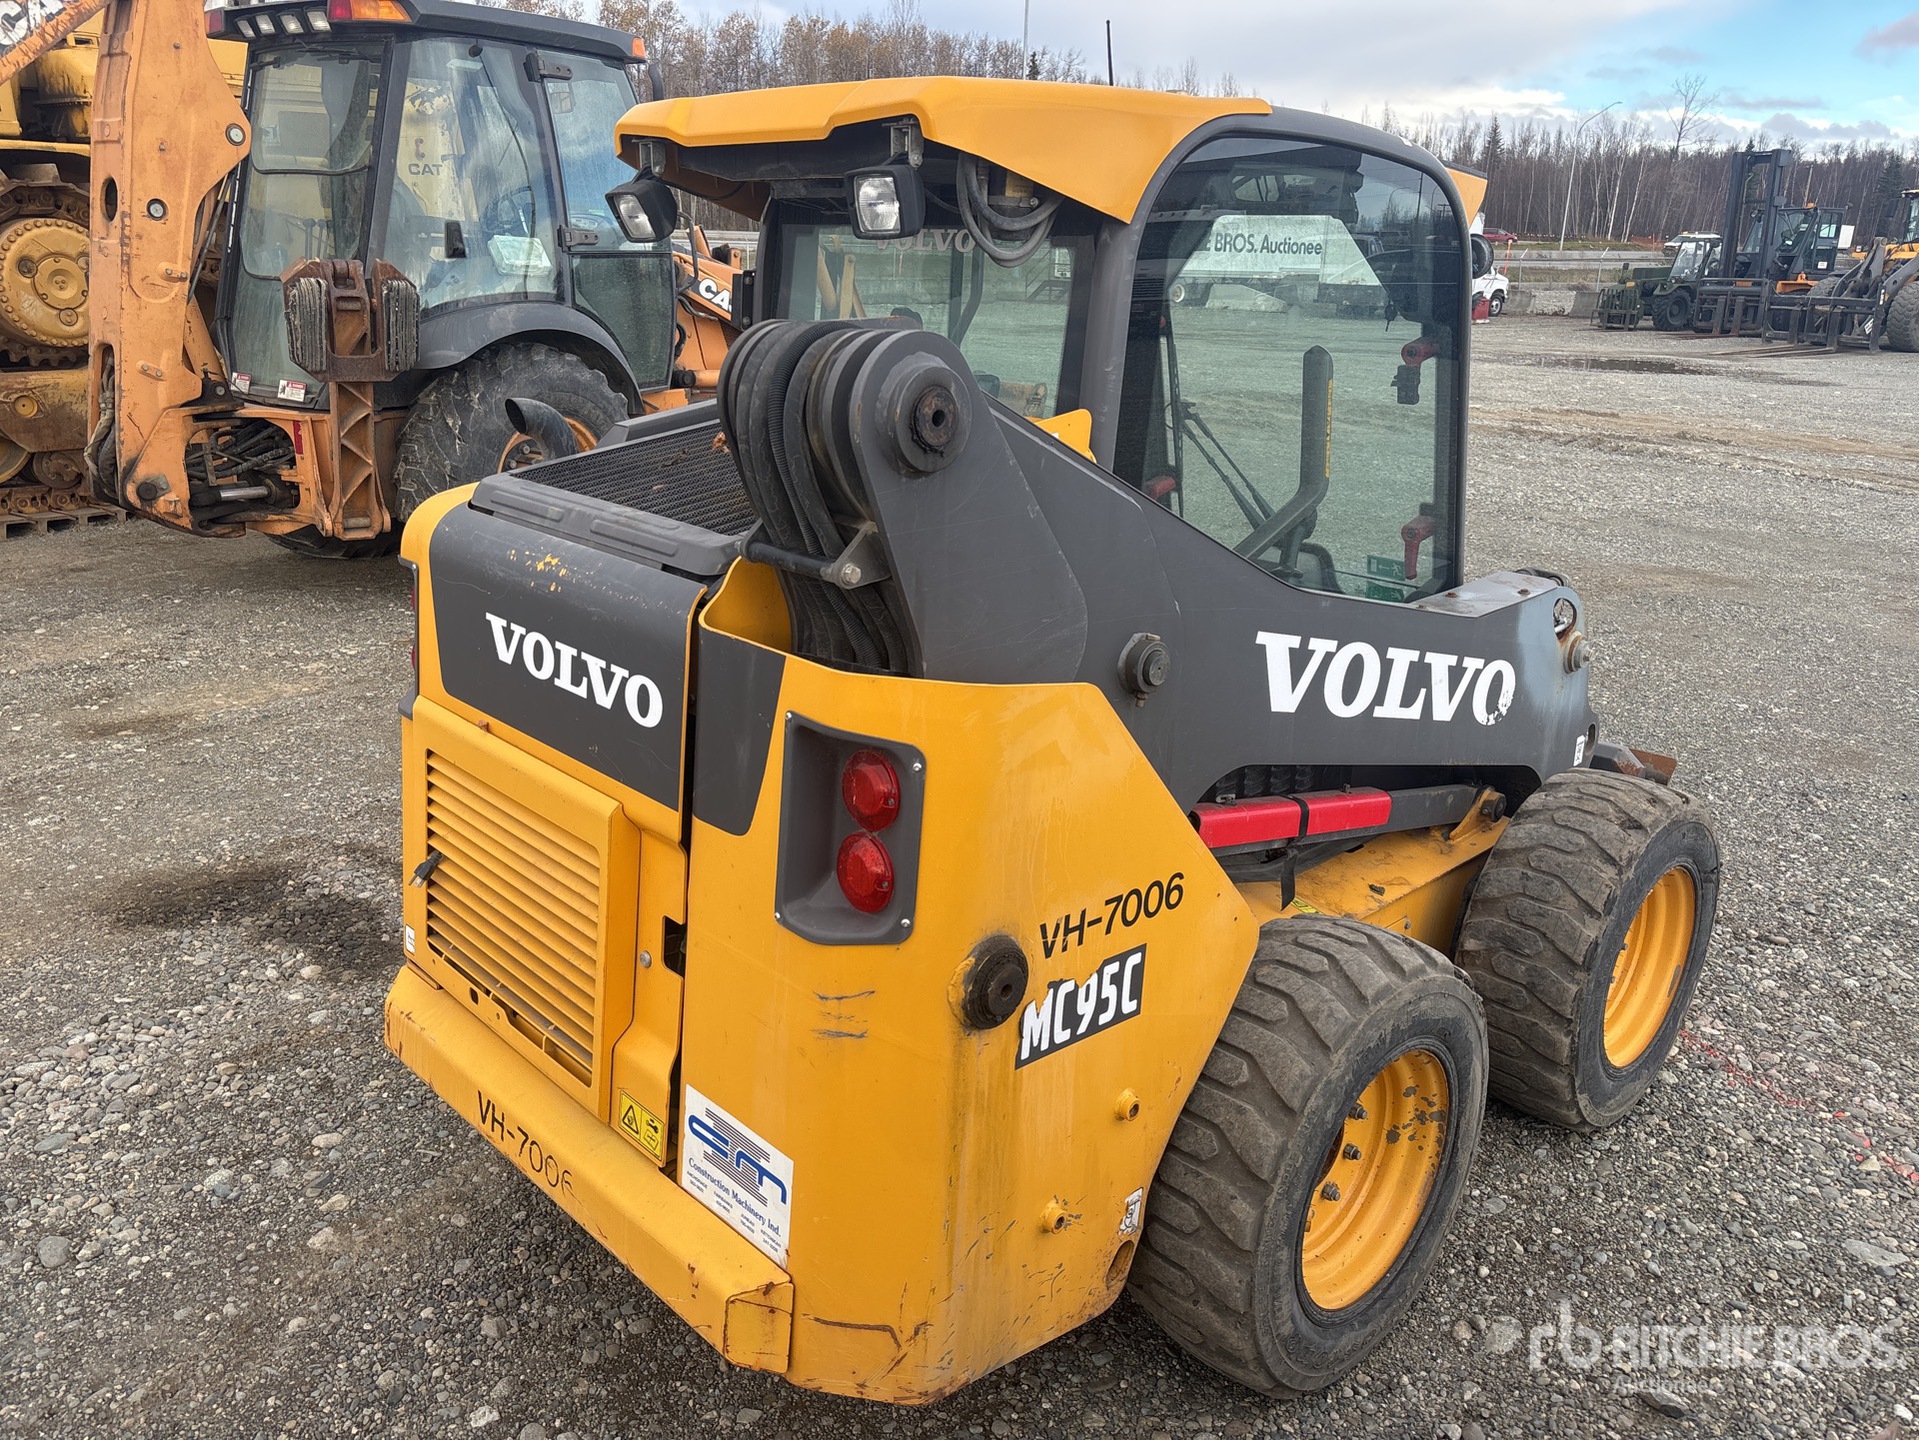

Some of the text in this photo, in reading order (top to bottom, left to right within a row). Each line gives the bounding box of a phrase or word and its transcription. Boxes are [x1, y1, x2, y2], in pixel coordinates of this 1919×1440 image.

[408, 163, 442, 176] CAT
[1214, 232, 1258, 254] BROS.
[699, 278, 733, 313] CA
[485, 612, 664, 728] VOLVO
[1255, 630, 1516, 726] VOLVO
[1040, 872, 1184, 960] VH-7006
[1020, 951, 1142, 1061] MC95C
[689, 1157, 730, 1196] Construction
[731, 1189, 766, 1226] Machinery
[767, 1218, 781, 1238] Ind.
